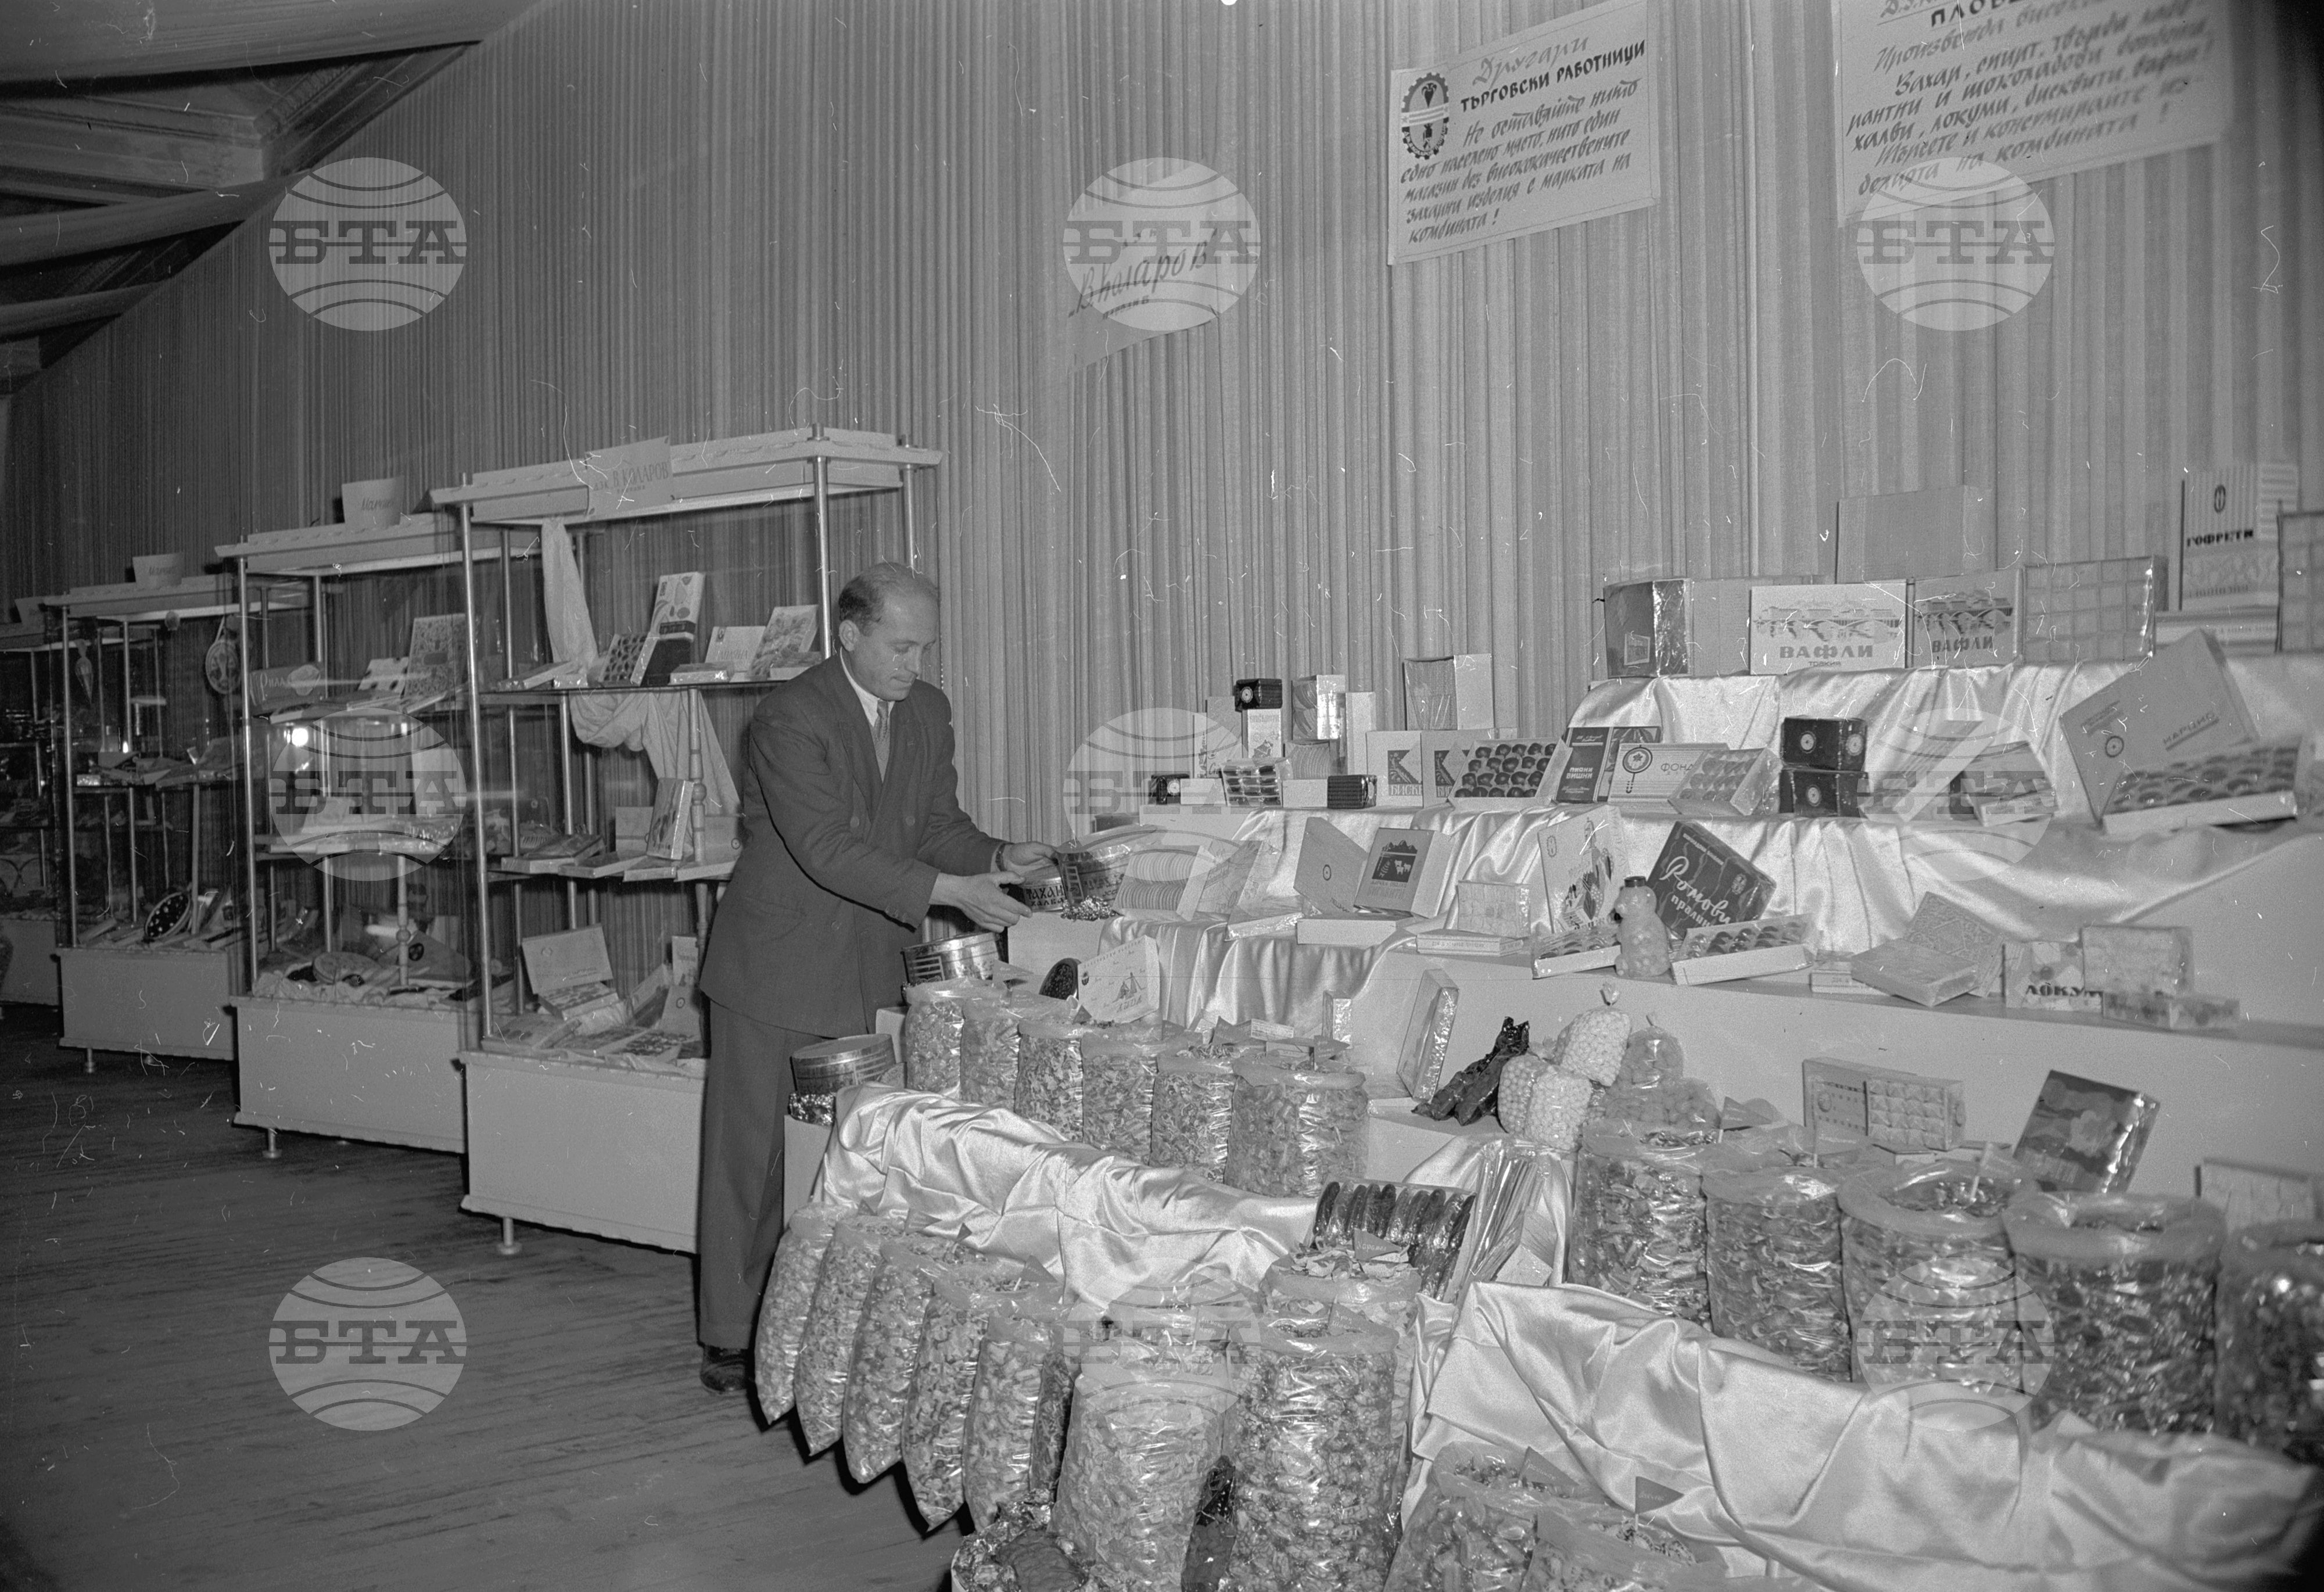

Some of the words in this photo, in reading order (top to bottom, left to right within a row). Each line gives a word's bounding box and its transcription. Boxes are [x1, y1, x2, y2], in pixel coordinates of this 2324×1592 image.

[1460, 71, 1551, 113] ТЪРГОВСКИ
[1556, 39, 1646, 84] РАБОТНИЦИ
[1472, 37, 1589, 90] Другари
[1462, 120, 1484, 148] Не
[1491, 94, 1586, 140] оставяйте
[1588, 77, 1643, 110] нито
[1935, 89, 1952, 109] и
[1400, 160, 1442, 184] едно
[1441, 143, 1503, 173] населено
[1546, 117, 1585, 146] нито
[1583, 107, 1622, 134] един
[1402, 179, 1460, 203] магазин
[1462, 165, 1482, 189] без
[1486, 128, 1631, 182] висококачествените
[1956, 152, 1985, 173] на
[1406, 198, 1462, 225] захарни
[1466, 181, 1522, 211] изделия
[1526, 177, 1536, 195] с
[1540, 158, 1606, 191] марката
[1611, 152, 1631, 173] на
[1408, 210, 1489, 245] комбината
[1779, 644, 1874, 659] ВАФЛИ
[1931, 636, 1994, 654] ВАФЛИ
[1026, 885, 1064, 900] ТАХАН
[1659, 855, 1731, 925] Ромови
